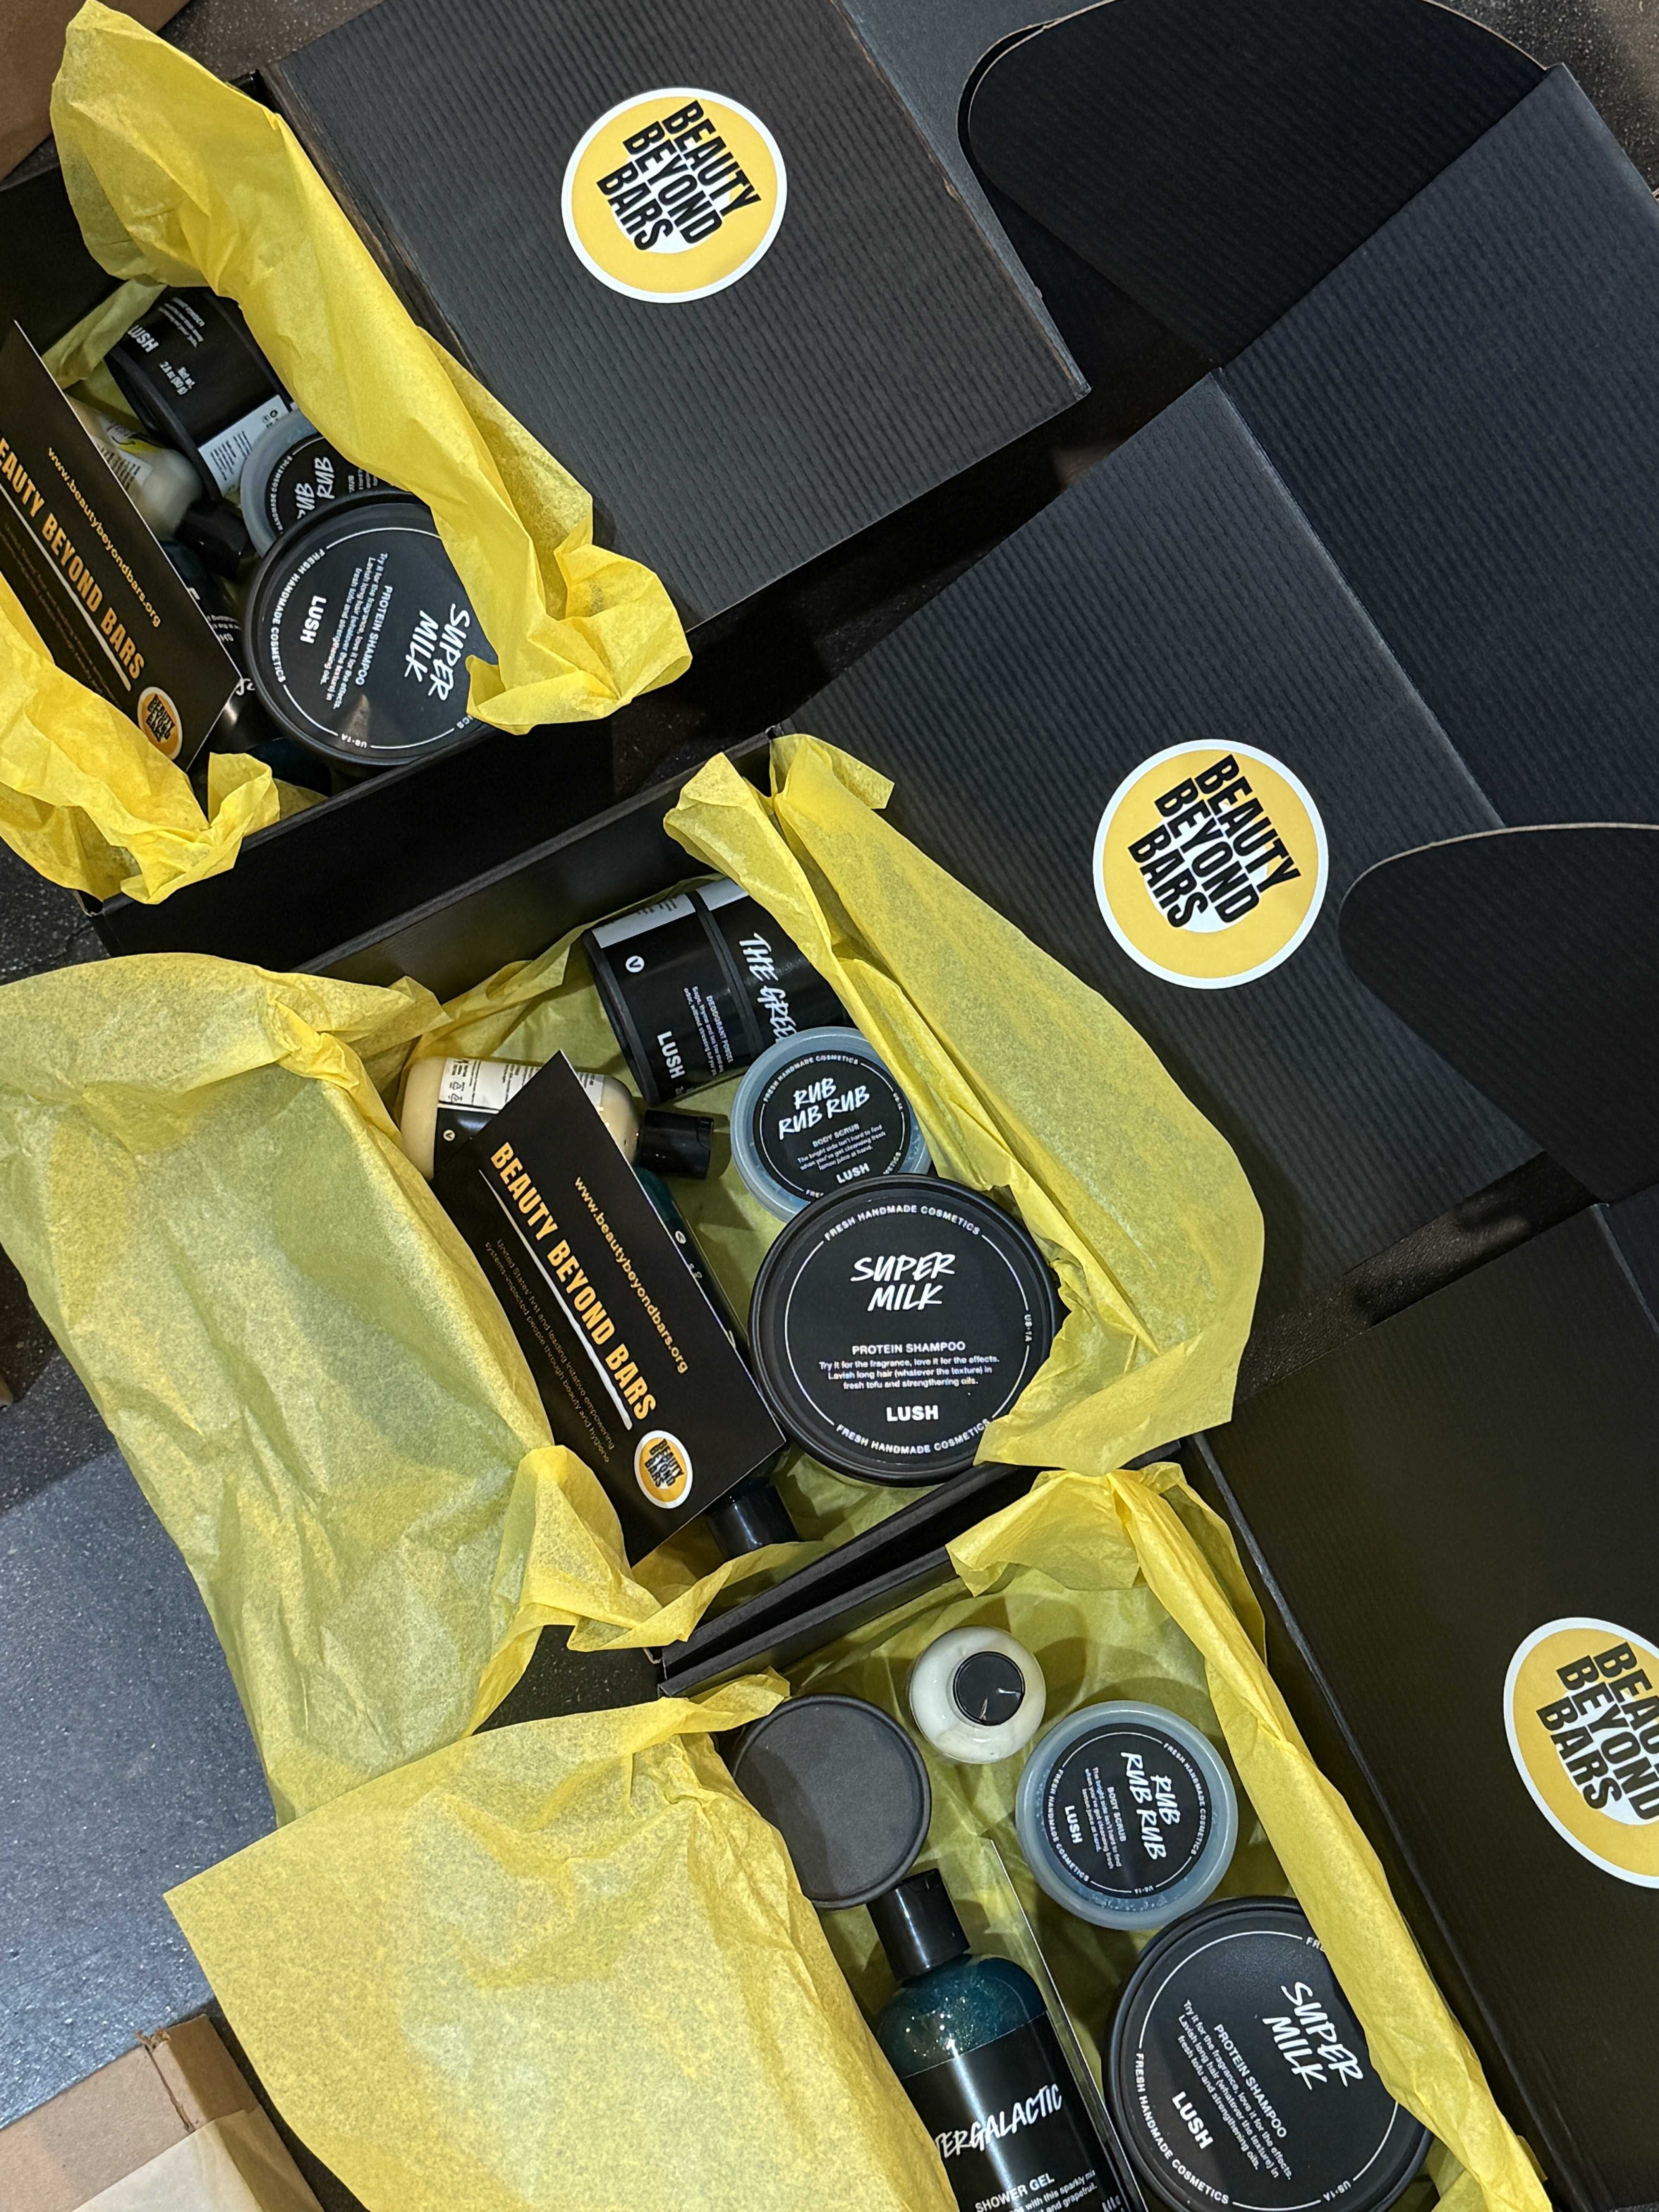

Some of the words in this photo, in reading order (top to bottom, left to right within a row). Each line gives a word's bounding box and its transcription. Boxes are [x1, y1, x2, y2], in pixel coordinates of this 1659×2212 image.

[622, 120, 723, 244] BEYOND
[662, 100, 761, 217] BEAUTY
[596, 162, 673, 251] BARS
[314, 456, 335, 500] RUB
[0, 434, 45, 517] EAUTY
[42, 512, 103, 613] BEYOND
[100, 607, 144, 680] BARS
[48, 447, 161, 627] www.beautybeyondbars.org
[298, 548, 325, 574] FRESH
[272, 573, 301, 625] HANDMADE
[300, 595, 326, 644] LUSH
[372, 585, 393, 631] PROTEIN
[271, 627, 286, 682] COSMETICS
[355, 632, 379, 685] SHAMPOO
[404, 610, 439, 682] MILK
[428, 603, 475, 701] SUPER
[1195, 754, 1301, 893] BEAUTY
[1154, 777, 1259, 923] BEYOND
[1128, 824, 1208, 928] BARS
[739, 932, 779, 982] THE
[706, 995, 726, 1039] DEODORANT
[757, 986, 798, 1044] GREE
[657, 1031, 685, 1079] LUSH
[777, 1057, 814, 1082] HANDMADE
[778, 1105, 823, 1140] RUB
[826, 1085, 870, 1119] RUB
[793, 1078, 836, 1110] RUB
[812, 1134, 832, 1147] BODY
[834, 1123, 860, 1139] SCRUB
[836, 1163, 870, 1183] LUSH
[824, 1216, 855, 1241] FRESH
[857, 1205, 917, 1221] HANDMADE
[921, 1206, 980, 1235] COSMETICS
[490, 1141, 557, 1241] BEAUTY
[547, 1239, 615, 1345] BEYOND
[605, 1343, 656, 1419] BARS
[575, 1177, 688, 1374] www.beautybeyondbars.org
[850, 1252, 955, 1282] SUPER
[867, 1283, 943, 1311] MILK
[819, 1361, 833, 1372] Try
[841, 1360, 854, 1369] for
[870, 1360, 912, 1369] fragrance,
[940, 1357, 952, 1365] for
[969, 1355, 1000, 1364] effects.
[828, 1371, 855, 1380] Lavish
[856, 1370, 875, 1379] long
[876, 1370, 893, 1378] hair
[894, 1369, 934, 1378] (whatever
[951, 1366, 983, 1375] texture)
[852, 1344, 903, 1355] PROTEIN
[906, 1341, 966, 1353] SHAMPOO
[843, 1381, 864, 1389] fresh
[866, 1381, 883, 1389] tofu
[884, 1379, 900, 1388] and
[902, 1378, 959, 1388] strengthening
[836, 1424, 868, 1446] FRESH
[871, 1441, 931, 1455] HANDMADE
[934, 1419, 990, 1450] COSMETICS
[886, 1405, 939, 1422] LUSH
[1593, 1642, 1659, 1773] BEAU
[1536, 1697, 1623, 1810] BARS
[1556, 1655, 1659, 1820] BEYOND
[1050, 1769, 1064, 1795] FRESH
[1120, 1752, 1153, 1803] RUB
[1150, 1775, 1181, 1825] RUB
[1184, 1763, 1206, 1807] HANDMADE
[1048, 1796, 1060, 1843] HANDMADE
[1065, 1805, 1083, 1843] LUSH
[1107, 1786, 1119, 1810] BODY
[1113, 1812, 1127, 1842] SCRUB
[1136, 1809, 1166, 1860] RUB
[1190, 1808, 1206, 1855] COSMETICS
[1056, 1843, 1089, 1882] COSMETICS
[1262, 2017, 1327, 2090] MILK
[1281, 1982, 1363, 2087] SUPER
[1135, 2053, 1145, 2092] FRESH
[1178, 2035, 1193, 2058] fresh
[1191, 2057, 1204, 2076] tofu
[1201, 2076, 1216, 2094] and
[1211, 2093, 1249, 2152] strengthening
[1178, 2014, 1197, 2043] Lavish
[1195, 2042, 1209, 2064] long
[1206, 2061, 1220, 2079] hair
[1216, 2079, 1245, 2119] (whatever
[1241, 2119, 1253, 2136] the
[1250, 2135, 1274, 2169] texture)
[1271, 2167, 1279, 2178] in
[1183, 1999, 1194, 2015] Try
[1191, 2014, 1199, 2023] it
[1195, 2021, 1206, 2035] for
[1203, 2035, 1214, 2051] the
[1212, 2049, 1239, 2094] fragrance,
[1237, 2092, 1252, 2112] love
[1249, 2110, 1257, 2119] it
[1253, 2118, 1264, 2131] for
[1262, 2131, 1273, 2147] the
[1271, 2147, 1292, 2180] effects.
[1214, 2024, 1250, 2077] PROTEIN
[1246, 2076, 1287, 2138] SHAMPOO
[934, 2083, 1062, 2160] TERGALACTIC
[1139, 2095, 1173, 2159] HANDMADE
[1172, 2091, 1213, 2149] LUSH
[975, 2184, 1028, 2212] SHOWER
[1029, 2173, 1055, 2191] GEL
[1025, 2197, 1043, 2210] with
[1043, 2190, 1059, 2202] this
[1060, 2176, 1085, 2195] sparkly
[1172, 2159, 1229, 2204] COSMETICS
